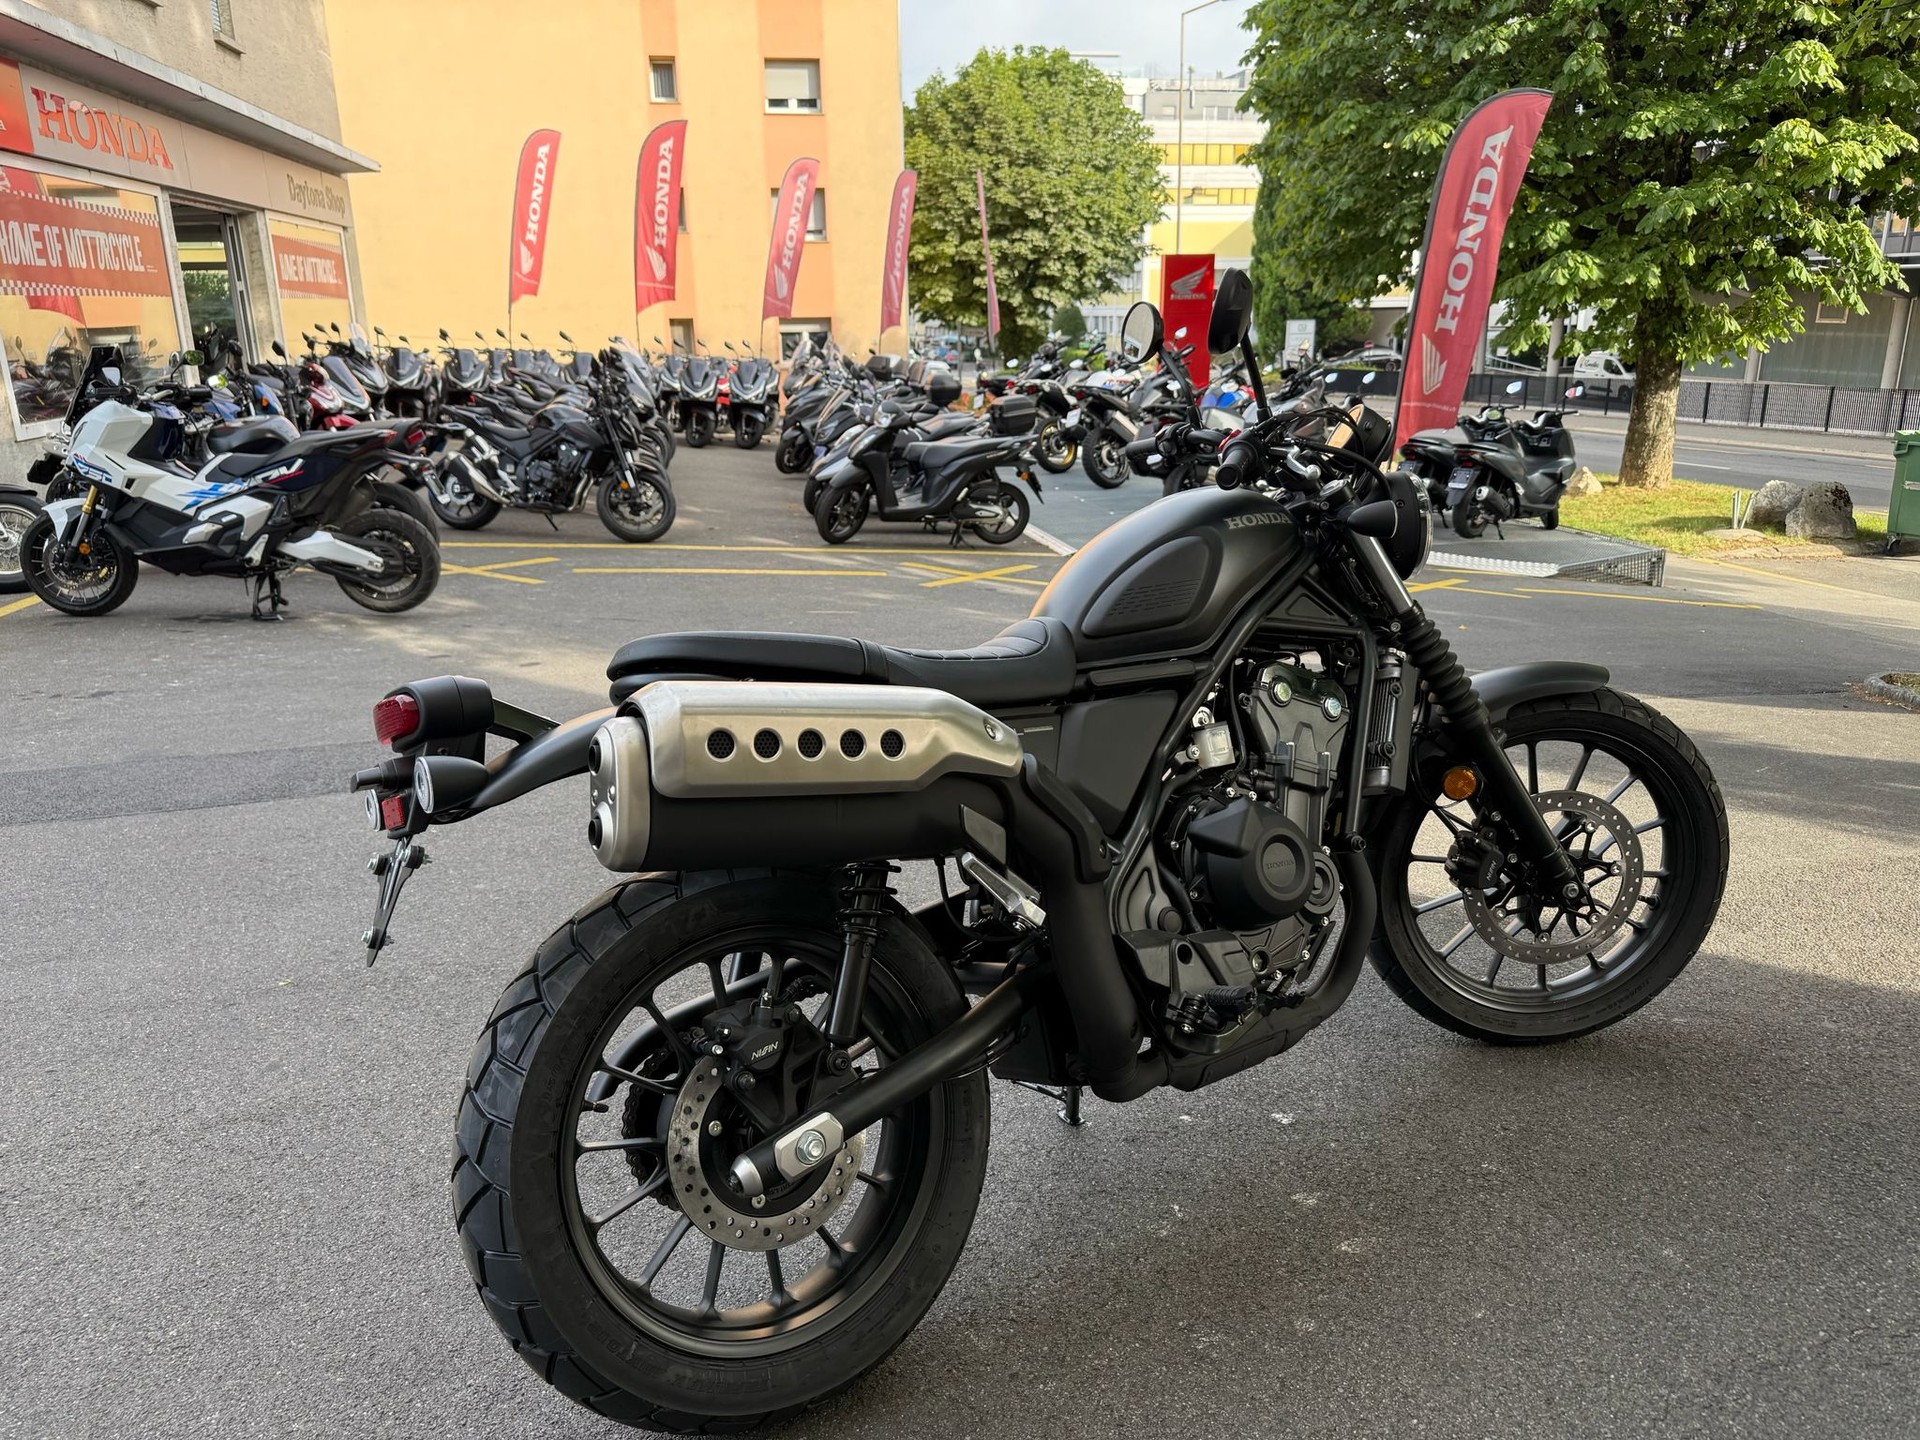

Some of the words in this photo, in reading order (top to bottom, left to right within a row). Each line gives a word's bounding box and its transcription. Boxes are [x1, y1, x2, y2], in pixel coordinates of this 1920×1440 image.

[30, 87, 174, 170] HONDA
[286, 173, 326, 210] Daytona
[325, 186, 346, 219] Shop
[525, 143, 551, 245] HONDA
[654, 136, 674, 249] HONDA
[781, 172, 810, 270] HONDA
[1434, 124, 1514, 337] HONDA
[43, 224, 63, 268] OF
[1223, 512, 1293, 530] HONDA
[1266, 859, 1295, 870] HONDA
